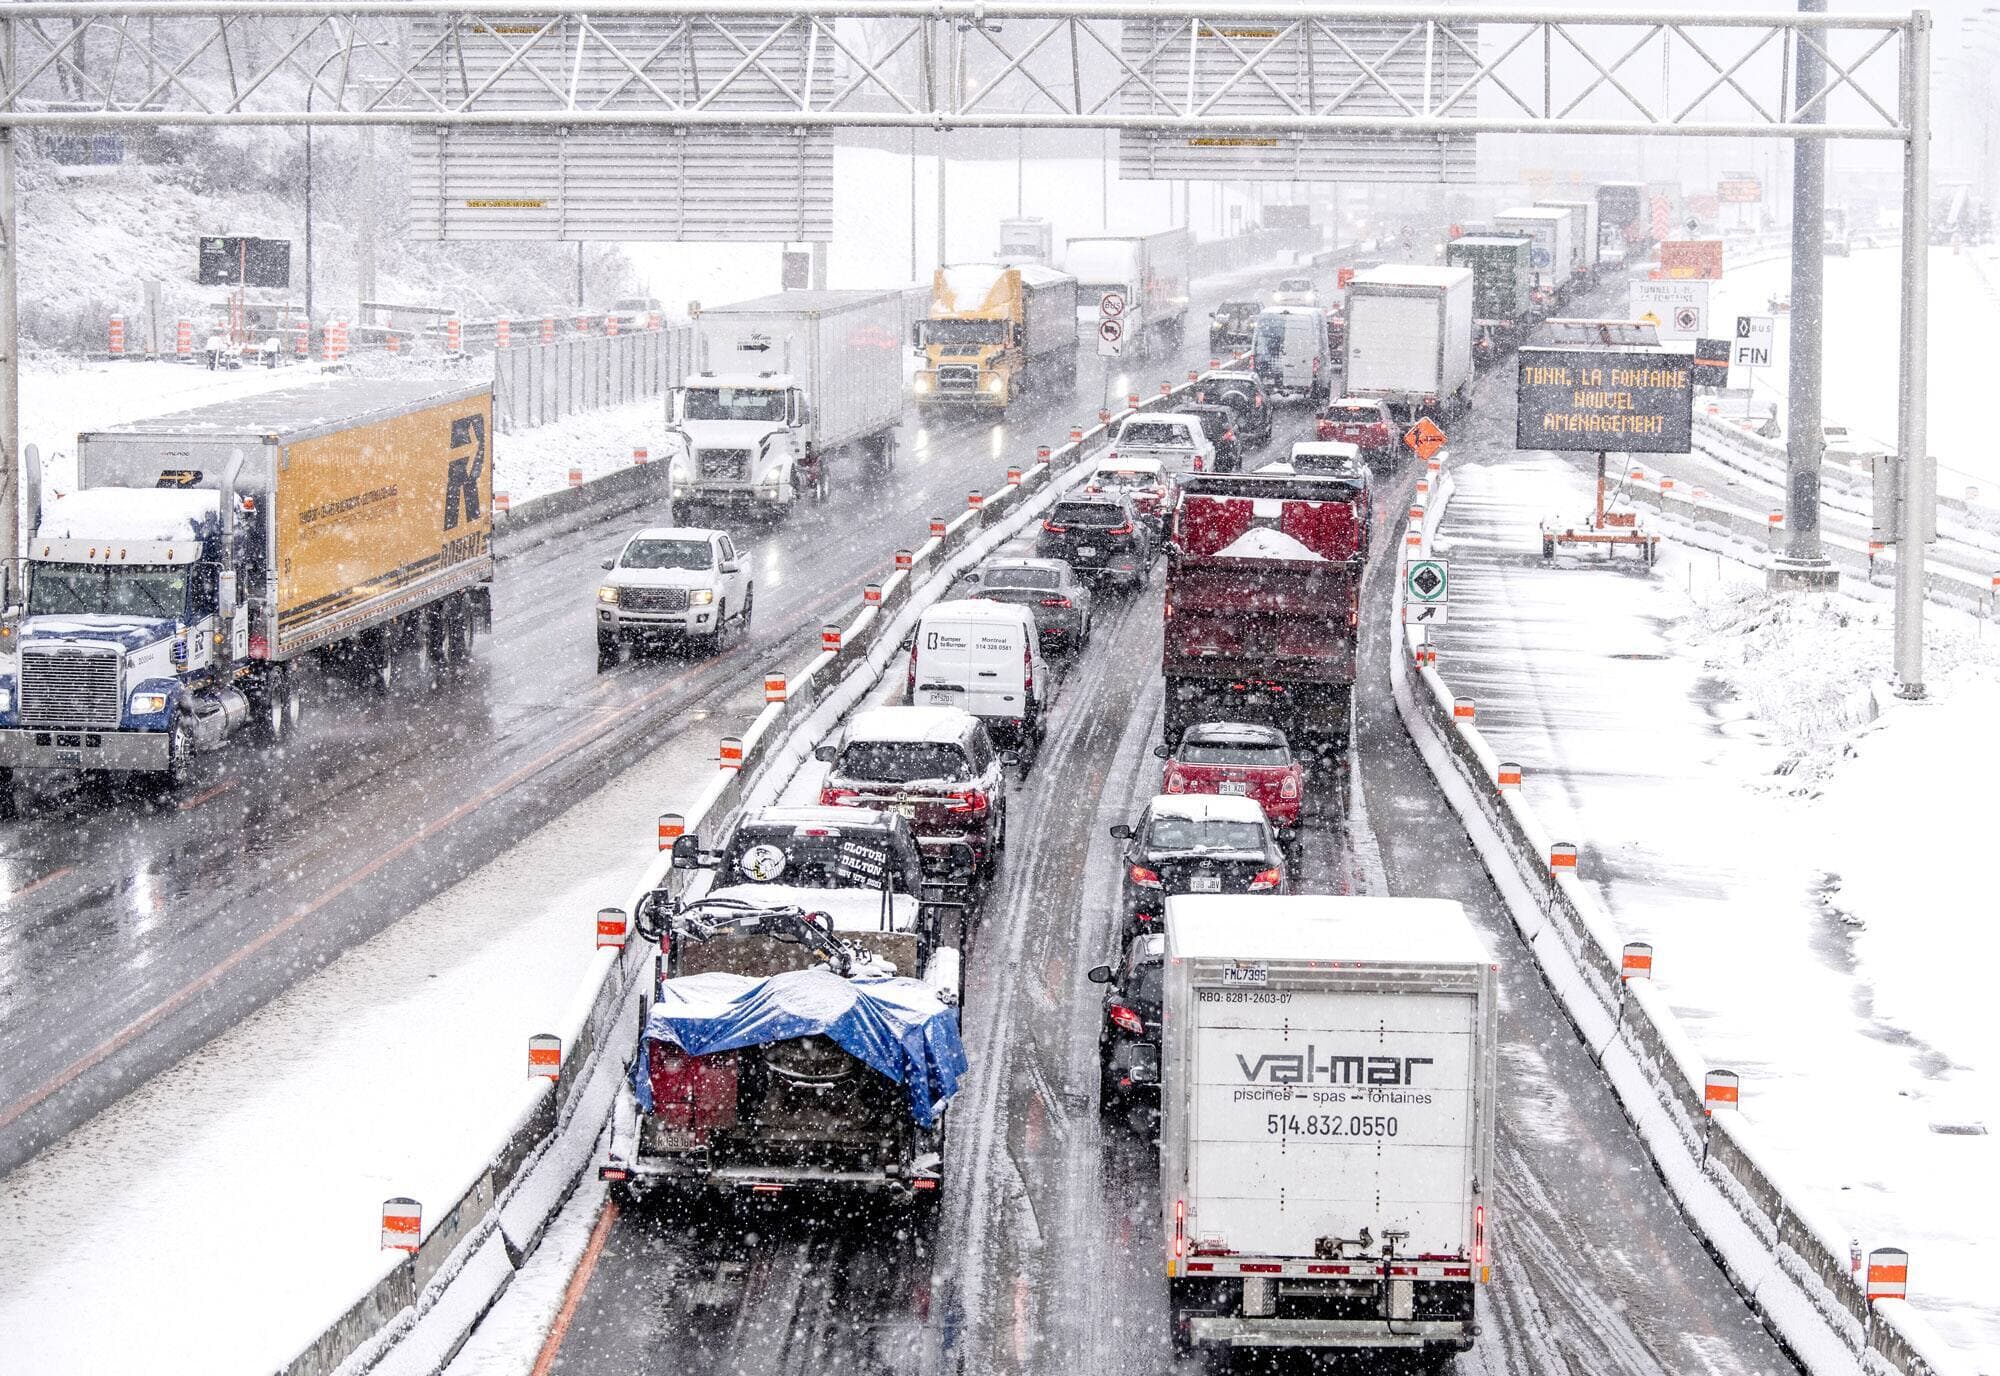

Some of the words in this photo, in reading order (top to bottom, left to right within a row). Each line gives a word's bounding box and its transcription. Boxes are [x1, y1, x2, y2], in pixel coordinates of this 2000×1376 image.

[1751, 324, 1771, 333] BUS
[1739, 347, 1768, 364] FIN
[1582, 368, 1601, 386] LA
[1611, 368, 1688, 388] FONTAINE
[1574, 391, 1635, 410] NOUVEL
[1543, 413, 1664, 433] AMENAGEMENT
[841, 854, 883, 876] DALTON
[1224, 968, 1266, 983] FMC7395
[1199, 992, 1224, 1004] RBQ:
[1225, 992, 1292, 1004] 8281-2603-07
[1235, 1044, 1434, 1085] val-mar
[1233, 1088, 1291, 1103] piscines
[1313, 1091, 1346, 1104] spas
[1368, 1089, 1432, 1105] fontaines
[1267, 1114, 1398, 1137] 514.832.0550
